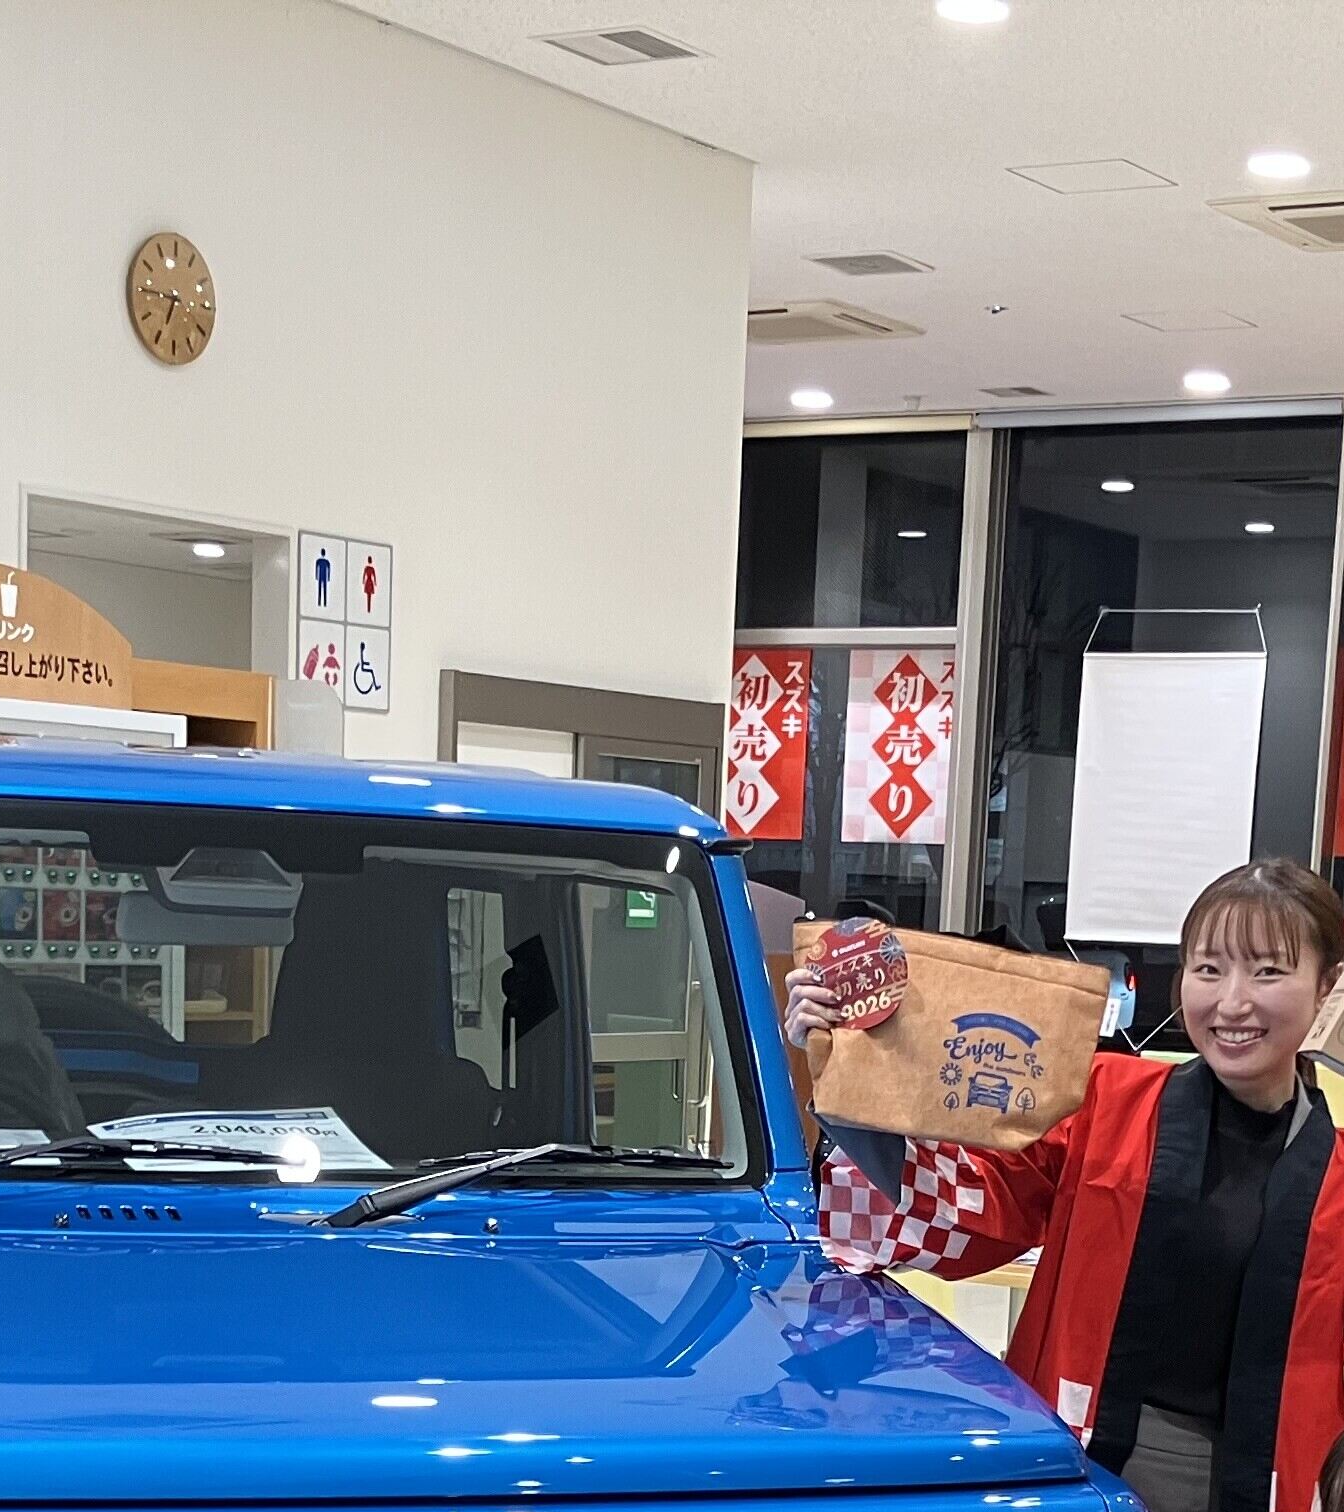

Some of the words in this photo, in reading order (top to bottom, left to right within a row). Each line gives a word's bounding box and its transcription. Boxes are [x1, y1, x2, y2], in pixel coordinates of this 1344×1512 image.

[781, 661, 804, 740] スズキ
[733, 671, 770, 817] 初売り
[885, 671, 926, 823] 初売り
[835, 953, 873, 977] スズキ
[841, 991, 891, 1021] 2026
[943, 1036, 1017, 1064] Enjoy
